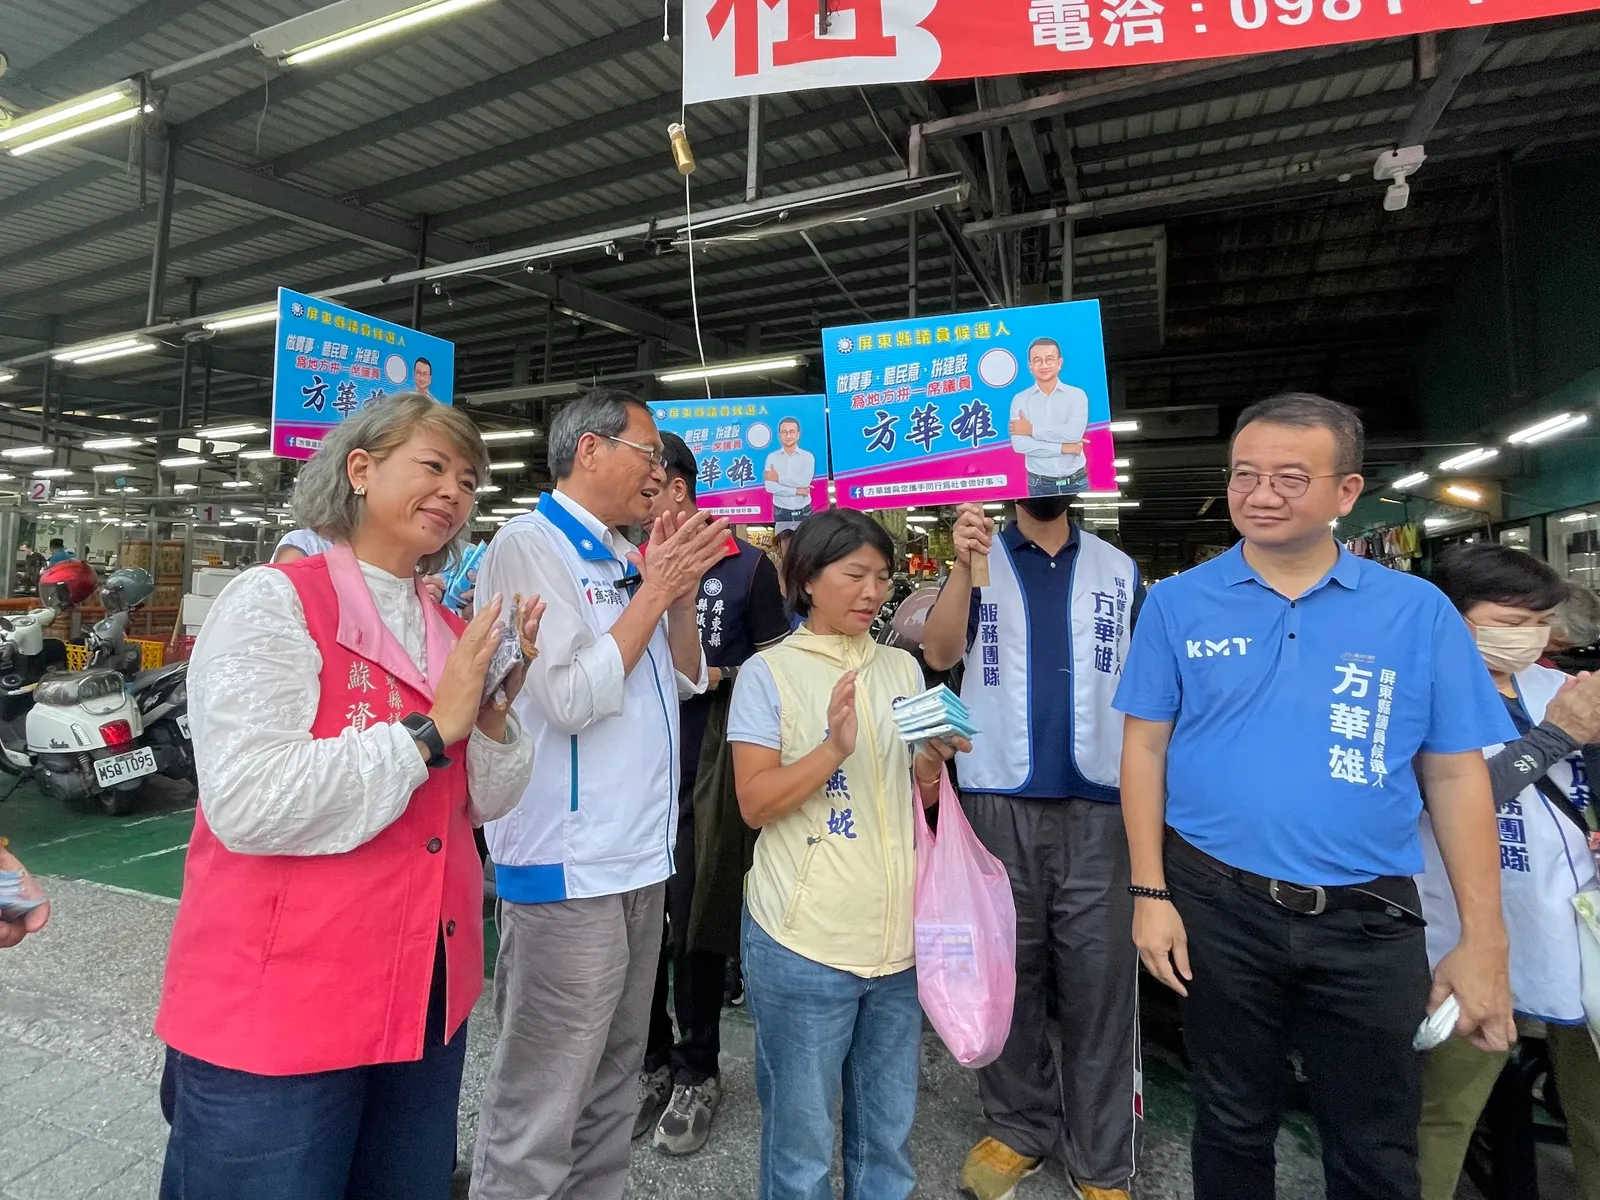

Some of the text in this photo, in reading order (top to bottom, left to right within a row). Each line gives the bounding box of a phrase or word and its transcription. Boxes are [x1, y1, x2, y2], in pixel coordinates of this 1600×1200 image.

[306, 306, 406, 348] 屏東縣議員候選人
[858, 320, 1011, 351] 屏東縣議員候選人
[669, 404, 768, 419] 屏東縣議員候選人
[863, 399, 998, 453] 方華雄
[32, 483, 46, 500] 2
[204, 506, 213, 521] 1
[708, 599, 725, 648] 屏東縣
[1091, 591, 1116, 674] 方華雄
[979, 603, 1001, 687] 服務團隊
[1186, 637, 1253, 659] KMT
[1328, 662, 1373, 785] 方華雄
[1368, 667, 1397, 789] 屏東縣議員候選人
[98, 753, 154, 781] MSQ-1095
